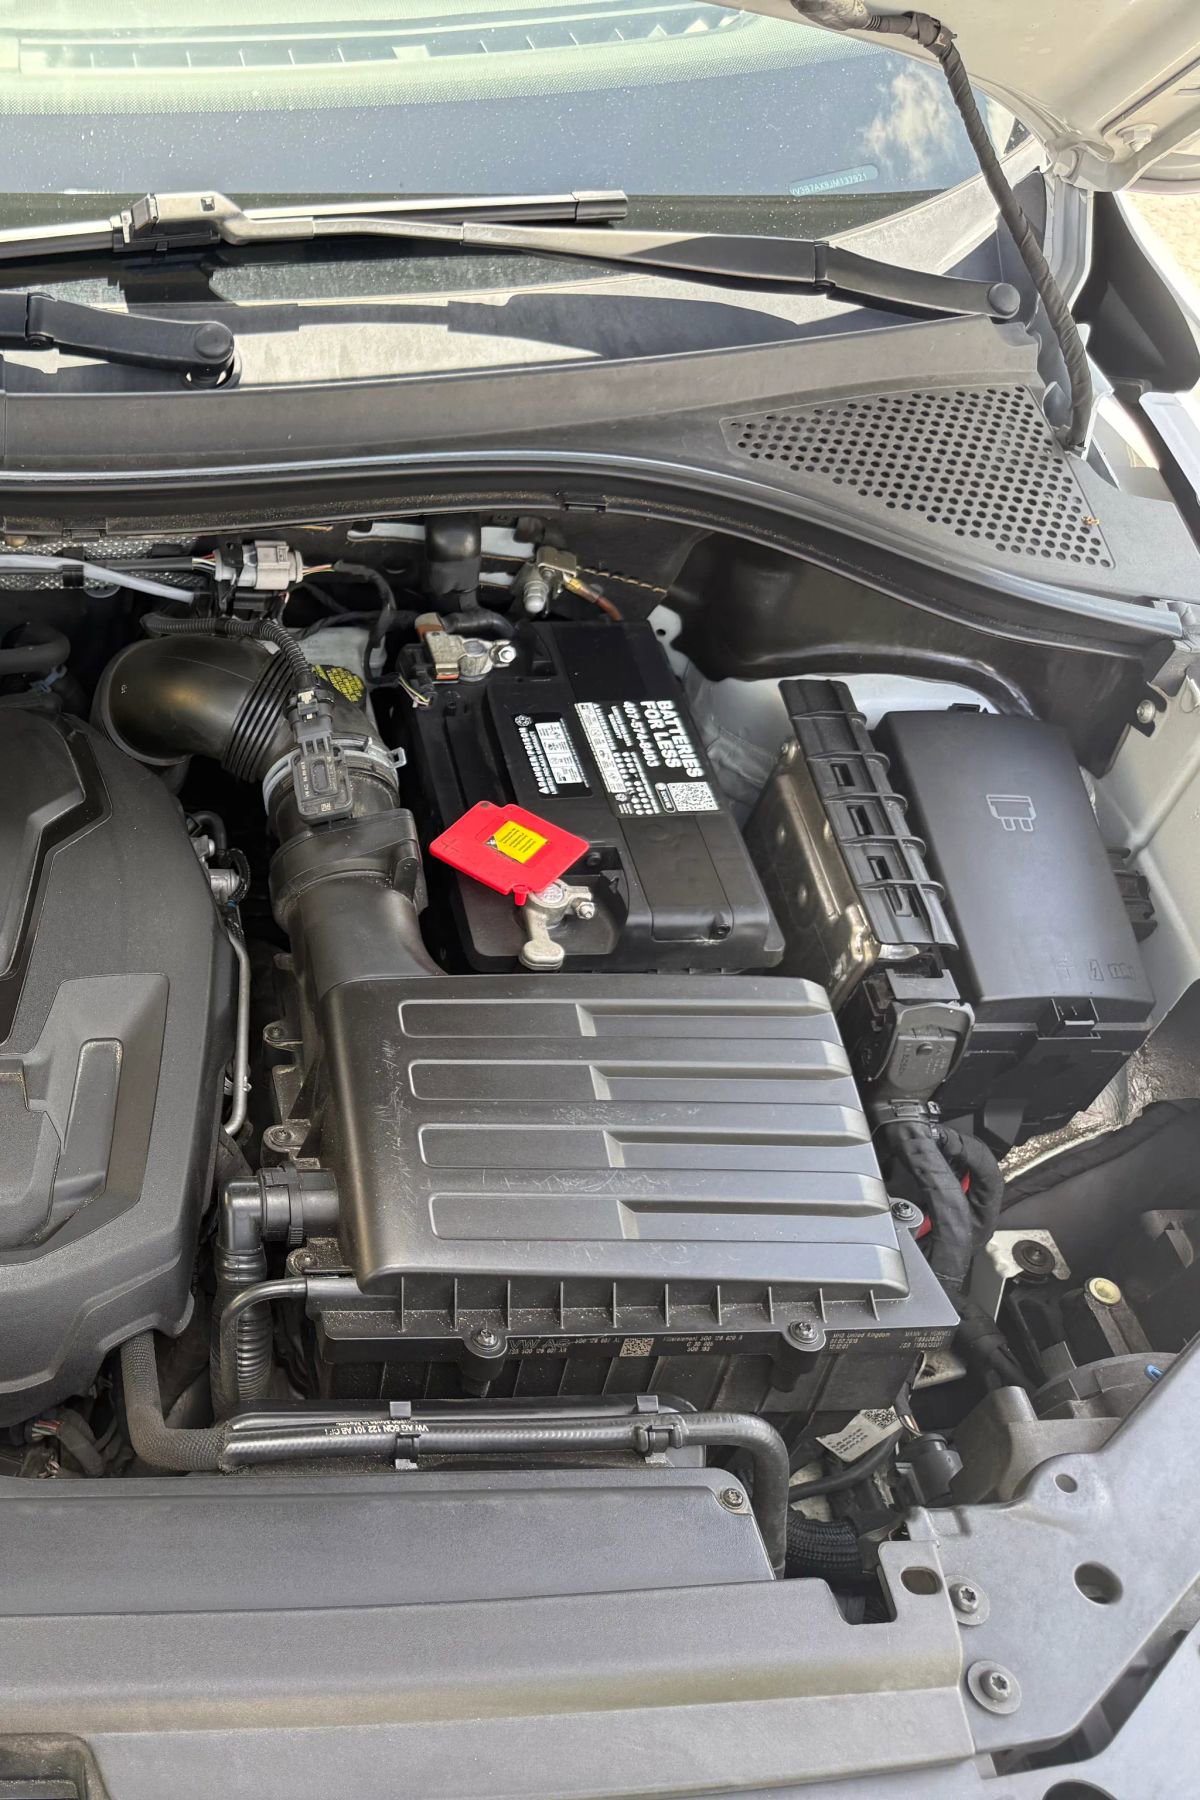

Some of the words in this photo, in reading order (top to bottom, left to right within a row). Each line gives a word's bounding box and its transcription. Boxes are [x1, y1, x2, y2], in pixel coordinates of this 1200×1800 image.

[623, 701, 661, 768] 407-574-8403
[640, 701, 666, 730] FOR
[653, 731, 683, 768] LESS
[656, 700, 705, 778] BATTERIES
[353, 1426, 367, 1434] 101
[368, 1425, 382, 1434] 122
[401, 1424, 415, 1432] AG
[415, 1424, 430, 1432] VW
